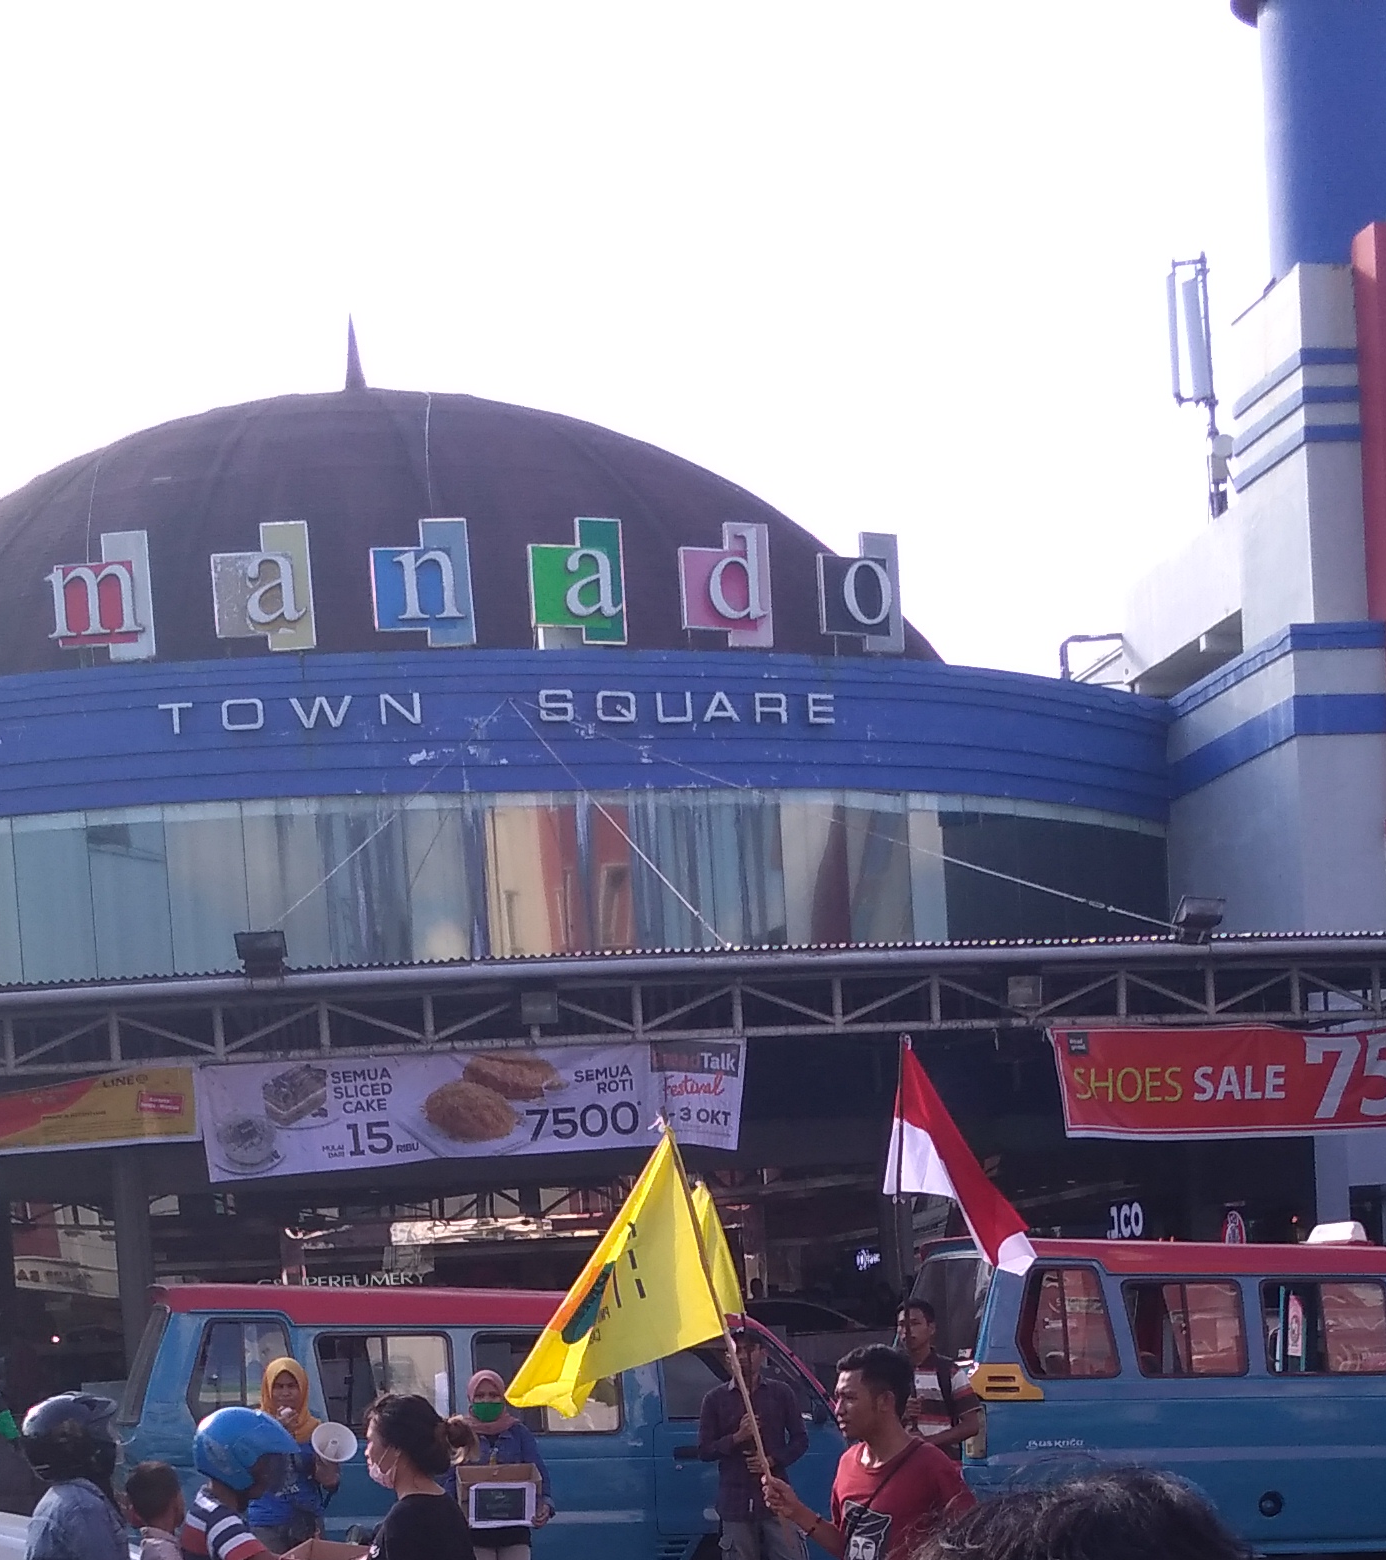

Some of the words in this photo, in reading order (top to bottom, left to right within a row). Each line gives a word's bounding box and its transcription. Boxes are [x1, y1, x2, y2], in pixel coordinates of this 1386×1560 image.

[45, 529, 893, 641] manado
[158, 691, 422, 735] TOWN
[537, 689, 837, 724] SQUARE
[330, 1067, 392, 1084] SEMUA
[574, 1064, 632, 1083] SEMUA
[333, 1082, 393, 1100] SLICED
[596, 1078, 634, 1094] ROTI
[1074, 1066, 1183, 1102] SHOES
[1194, 1065, 1286, 1101] SALE
[342, 1098, 387, 1114] CAKE
[696, 1108, 731, 1126] OKT
[346, 1120, 393, 1157] 15
[396, 1142, 420, 1154] RIBU
[305, 1271, 425, 1287] PERFUMERY
